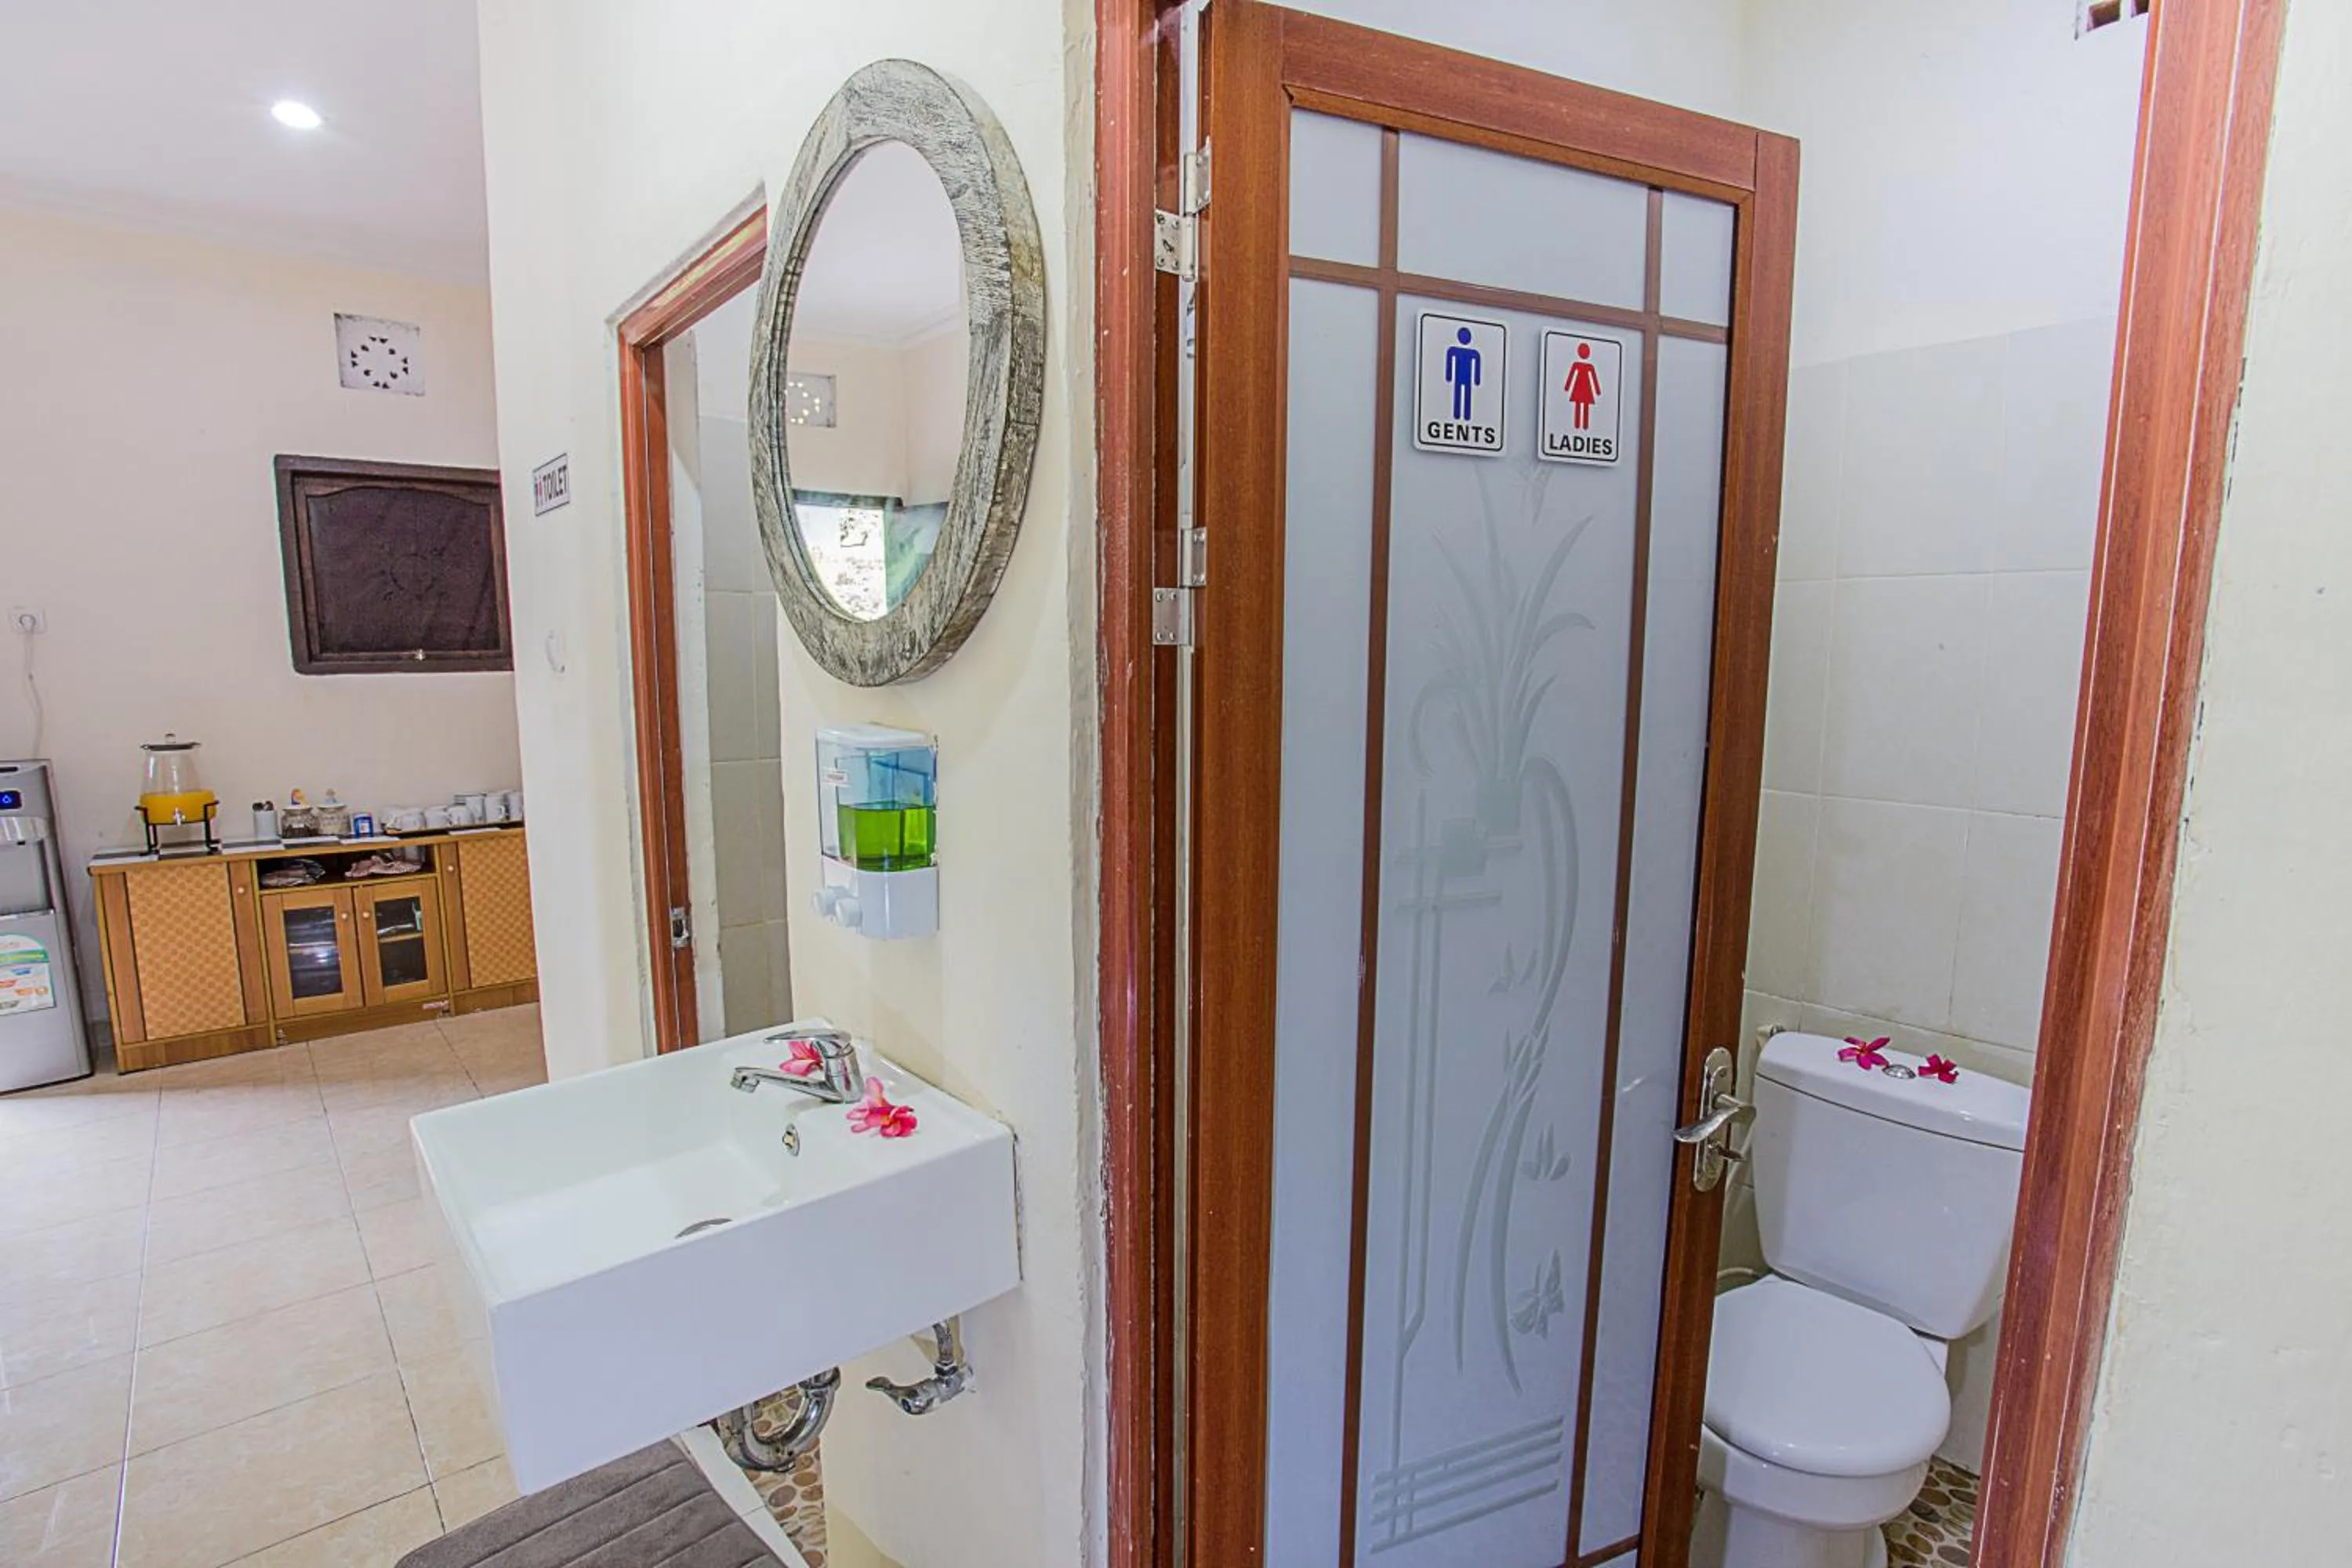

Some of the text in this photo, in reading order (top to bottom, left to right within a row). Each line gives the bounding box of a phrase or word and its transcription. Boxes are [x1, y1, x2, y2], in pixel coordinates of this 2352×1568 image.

[1427, 421, 1496, 444] GENTS
[1548, 433, 1613, 456] LADIES
[543, 464, 568, 503] TOILET
